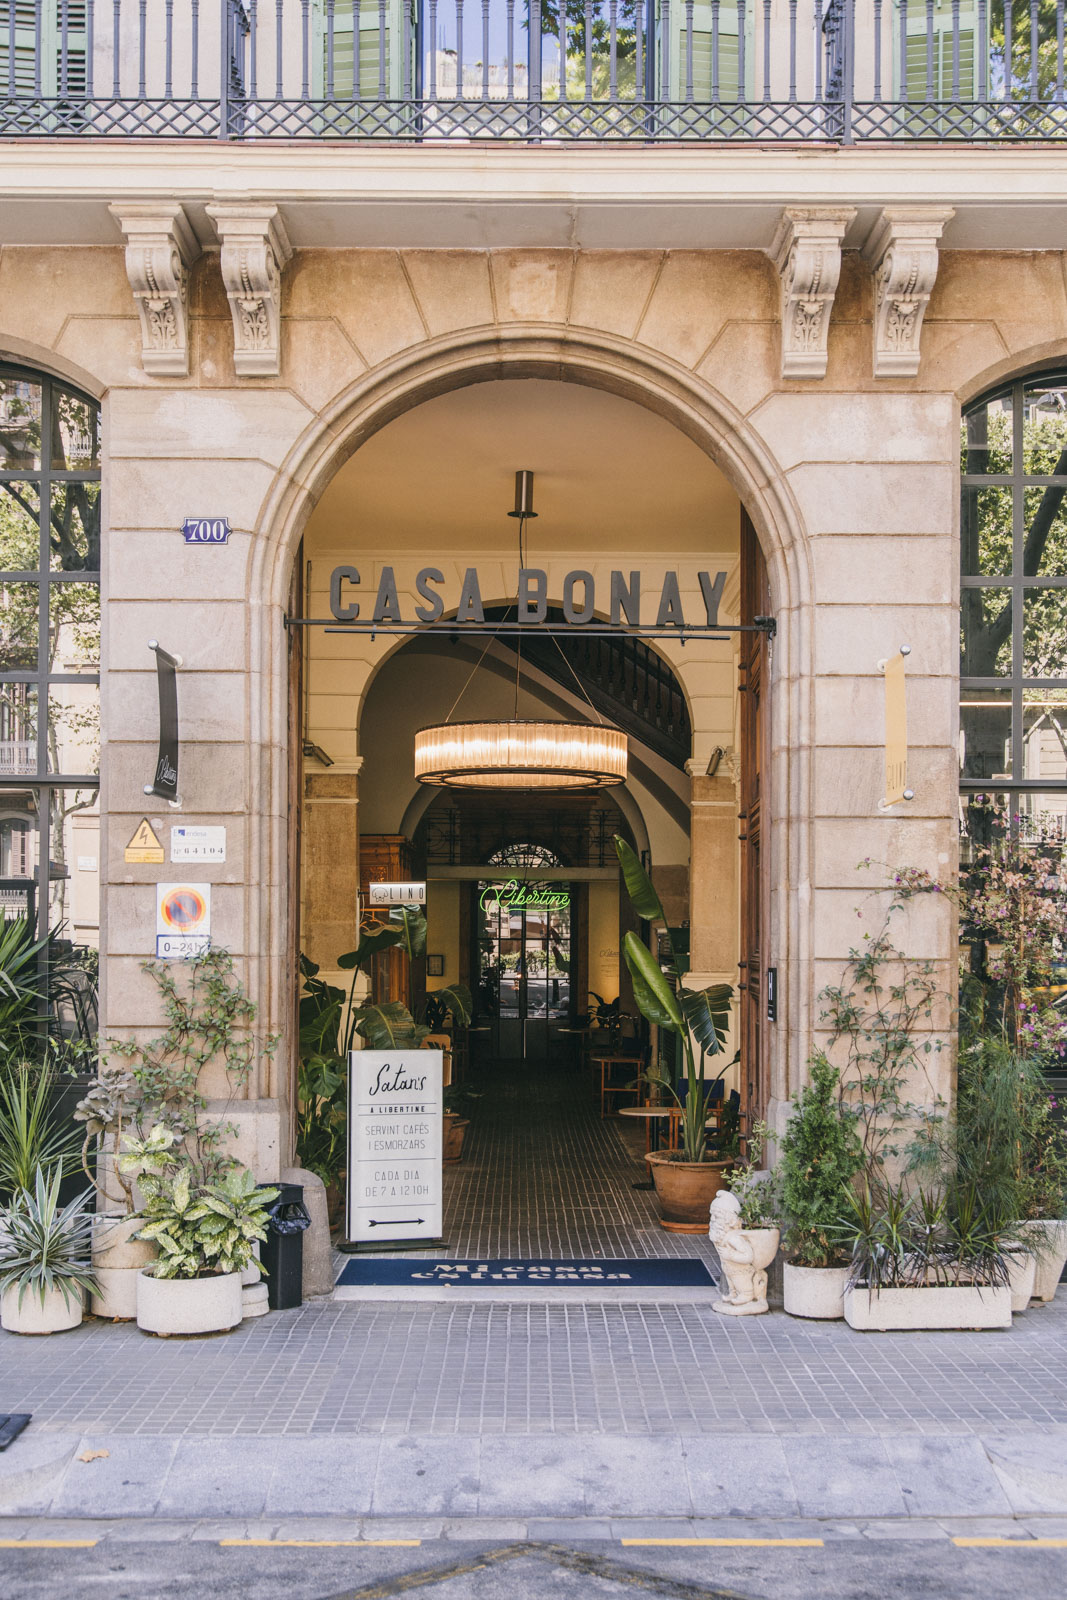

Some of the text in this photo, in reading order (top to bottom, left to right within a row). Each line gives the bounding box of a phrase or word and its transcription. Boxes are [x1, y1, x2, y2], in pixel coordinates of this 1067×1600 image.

[187, 520, 225, 541] 700
[330, 565, 728, 627] CASA BONAY
[389, 887, 425, 900] LINO
[480, 879, 571, 913] Libertine
[368, 1063, 427, 1096] Satan's
[379, 1105, 425, 1114] LIBERTINE
[365, 1124, 400, 1136] SERVINT
[374, 1139, 426, 1151] ESMORZARS
[374, 1169, 420, 1182] CADA DIA
[365, 1186, 378, 1198] DE
[380, 1186, 387, 1197] 7
[390, 1185, 396, 1196] A
[433, 1264, 603, 1273] Mi casa
[410, 1271, 632, 1280] es tu casa
